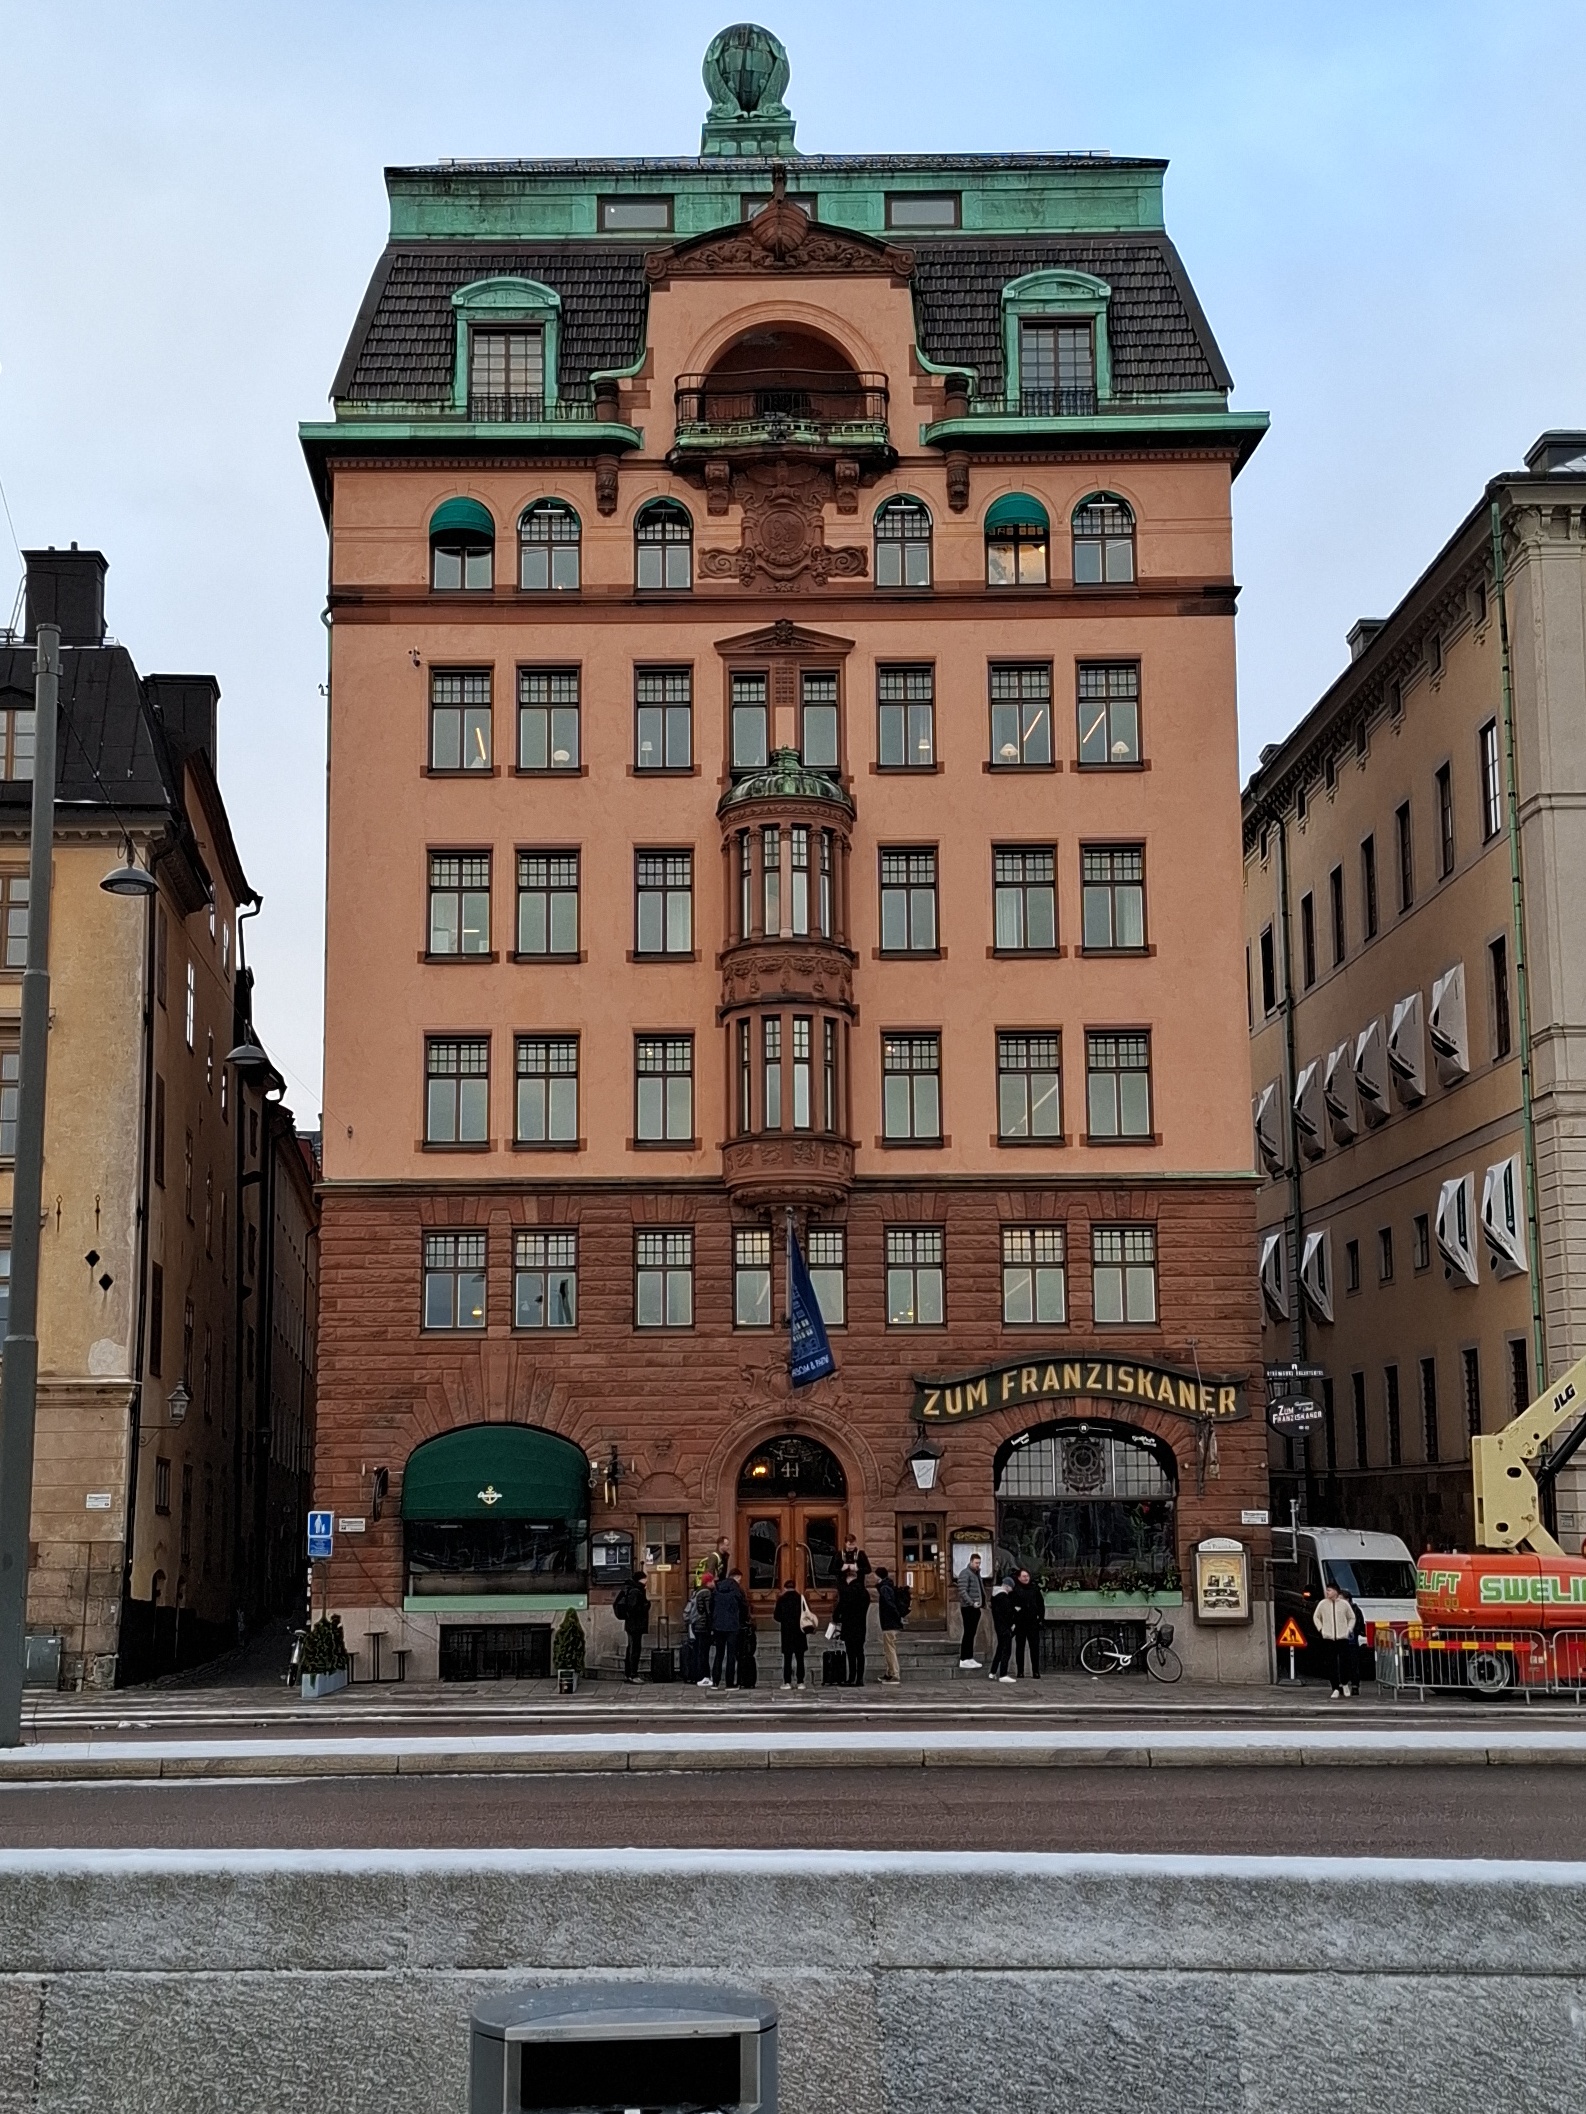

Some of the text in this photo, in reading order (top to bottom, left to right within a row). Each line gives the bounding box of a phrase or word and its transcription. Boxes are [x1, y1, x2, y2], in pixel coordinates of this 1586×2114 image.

[923, 1362, 1237, 1415] ZUM FRANZISKANER
[1553, 1383, 1576, 1413] JLG
